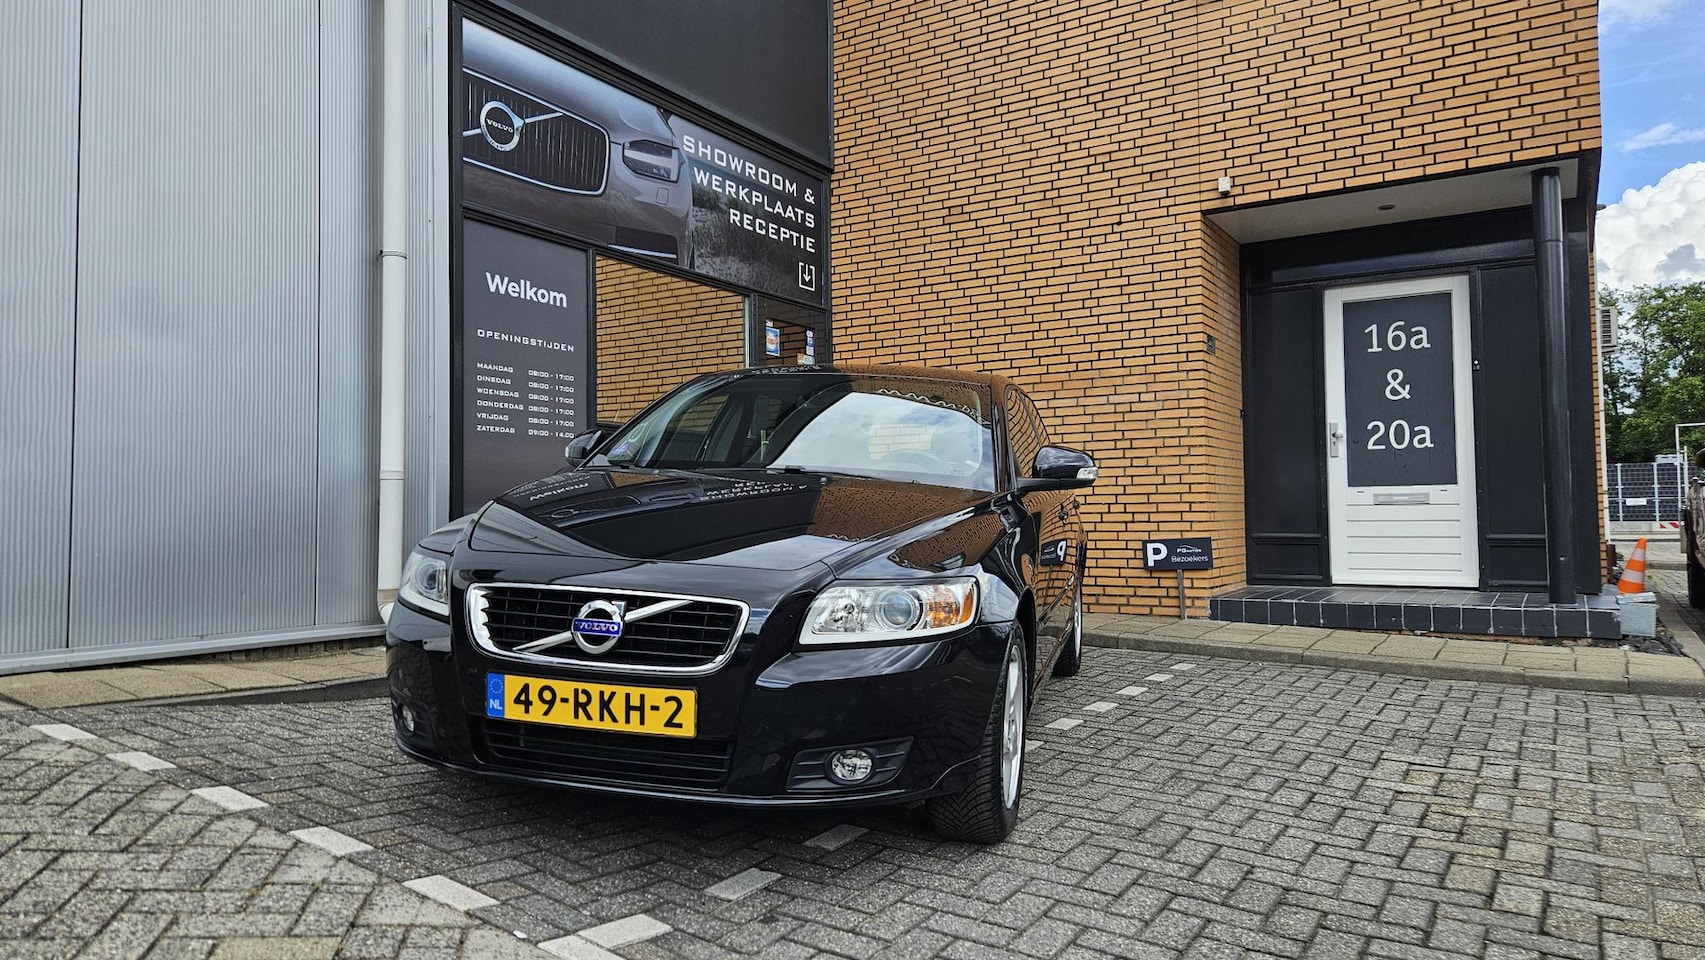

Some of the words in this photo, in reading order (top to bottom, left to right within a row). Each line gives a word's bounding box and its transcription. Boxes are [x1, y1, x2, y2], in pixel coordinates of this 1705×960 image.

[486, 118, 514, 133] VOLVO
[683, 135, 797, 197] SHOWROOM
[804, 188, 816, 204] &
[693, 166, 815, 228] WERKPLAATS
[729, 208, 816, 253] RECEPTIE
[485, 272, 568, 308] Welkom
[477, 328, 574, 352] OPENINGSTIJDEN
[1364, 321, 1431, 352] 16a
[476, 362, 514, 373] MAANDAG
[476, 374, 512, 385] DINSDAG
[1384, 368, 1412, 401] &
[476, 387, 519, 398] WOENSDAG
[476, 399, 524, 410] DONDERDAG
[476, 412, 509, 421] VRIJDAG
[476, 424, 516, 434] ZATERDAG
[1366, 419, 1435, 451] 20a
[1146, 542, 1168, 567] P
[1171, 555, 1209, 563] Bezoekers
[574, 620, 619, 632] VOLVO
[489, 698, 503, 710] NL
[513, 682, 684, 729] 49-RKH-2
